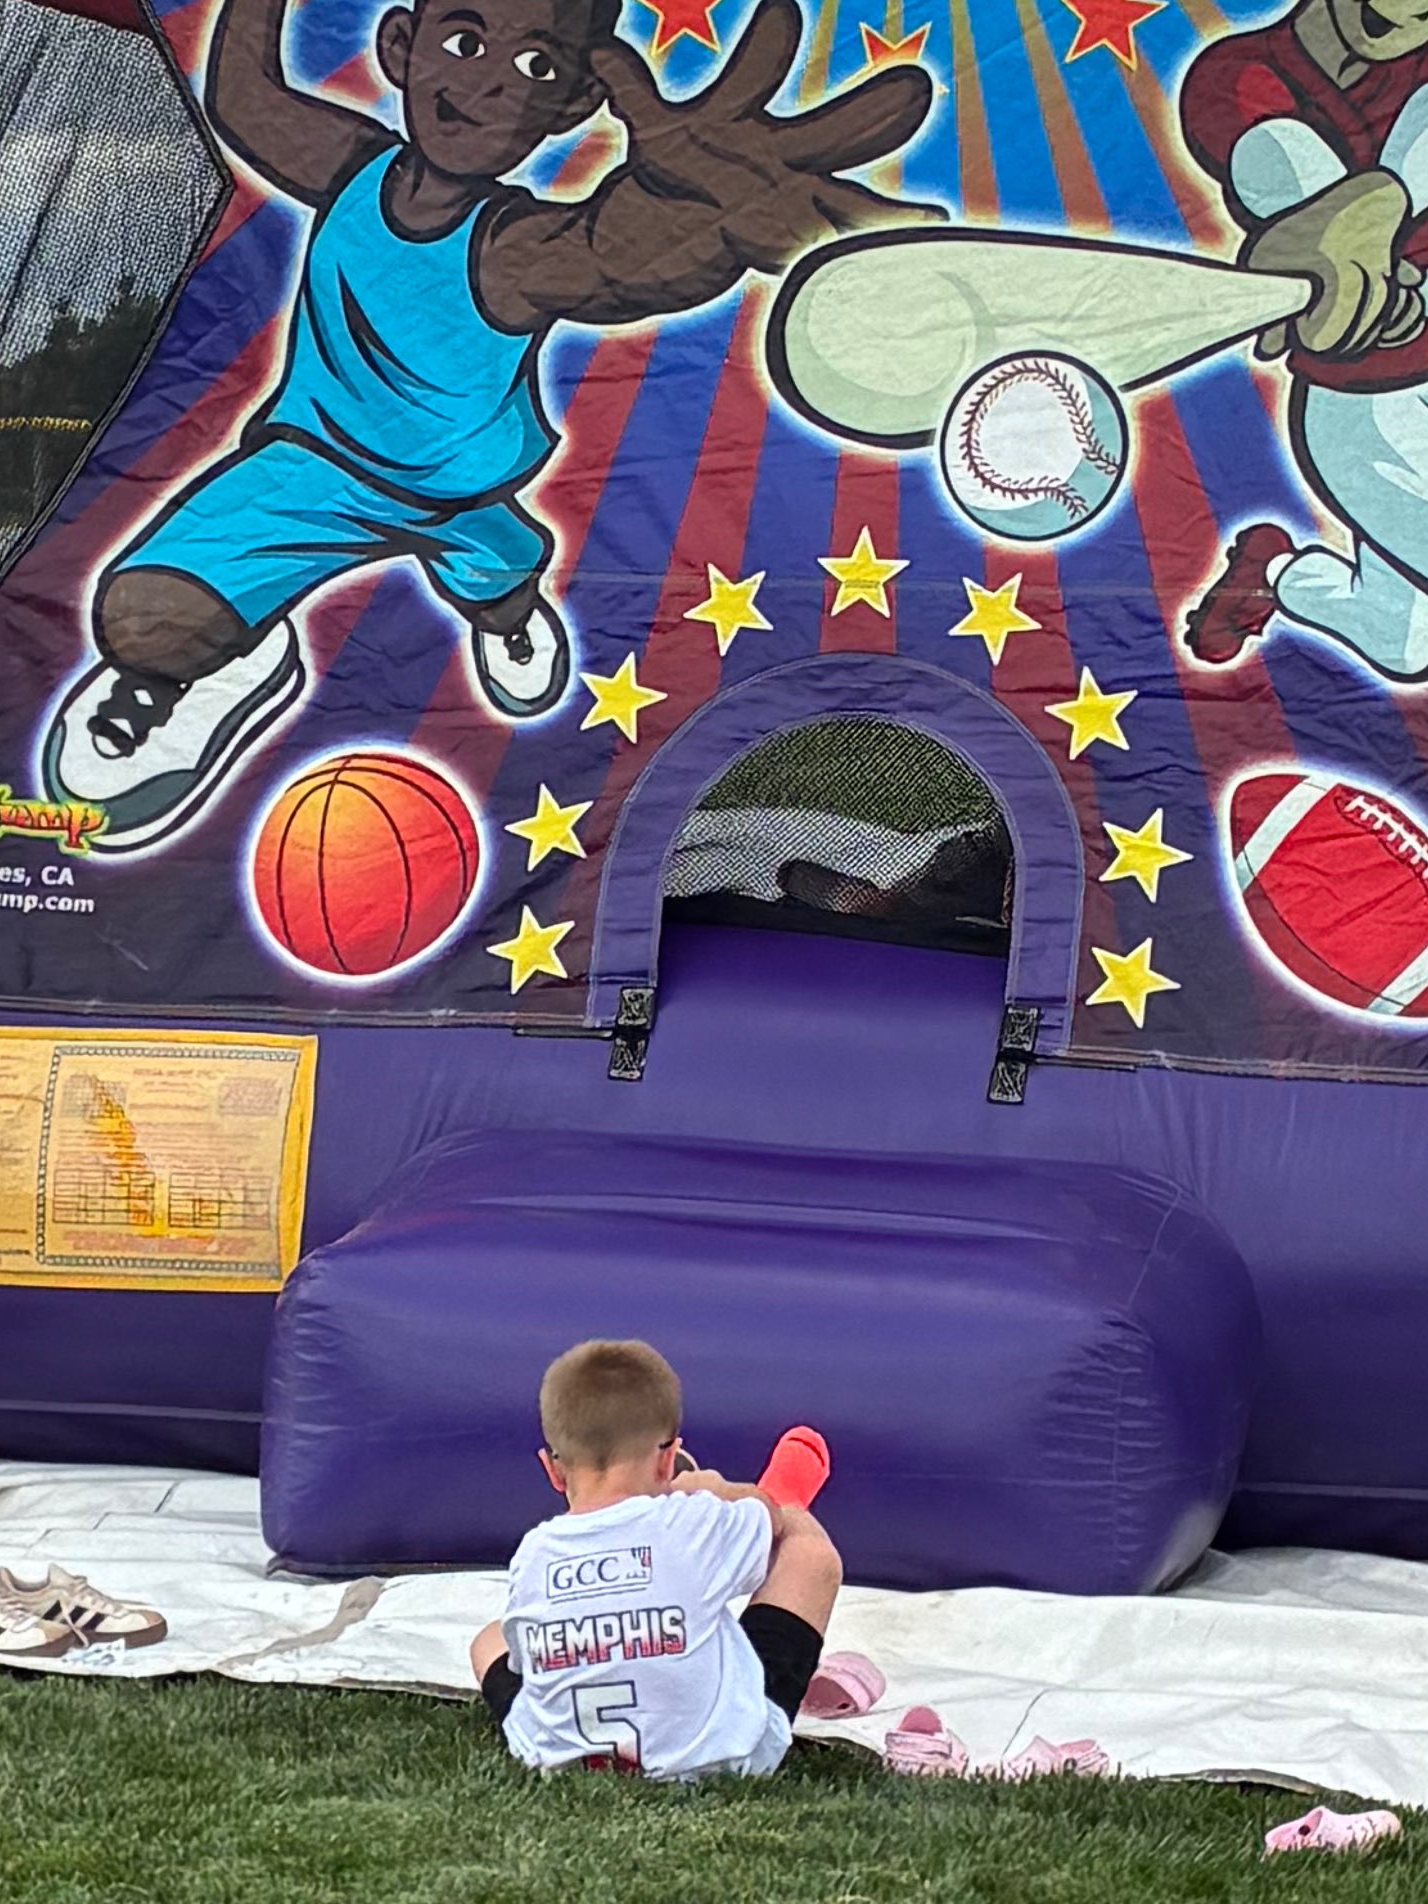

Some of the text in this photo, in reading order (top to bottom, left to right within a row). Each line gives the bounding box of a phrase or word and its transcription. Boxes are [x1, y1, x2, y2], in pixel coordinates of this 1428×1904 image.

[41, 865, 75, 886] CA
[552, 1556, 620, 1591] GCC
[526, 1605, 686, 1675] MEMPHIS
[571, 1679, 642, 1774] 5
